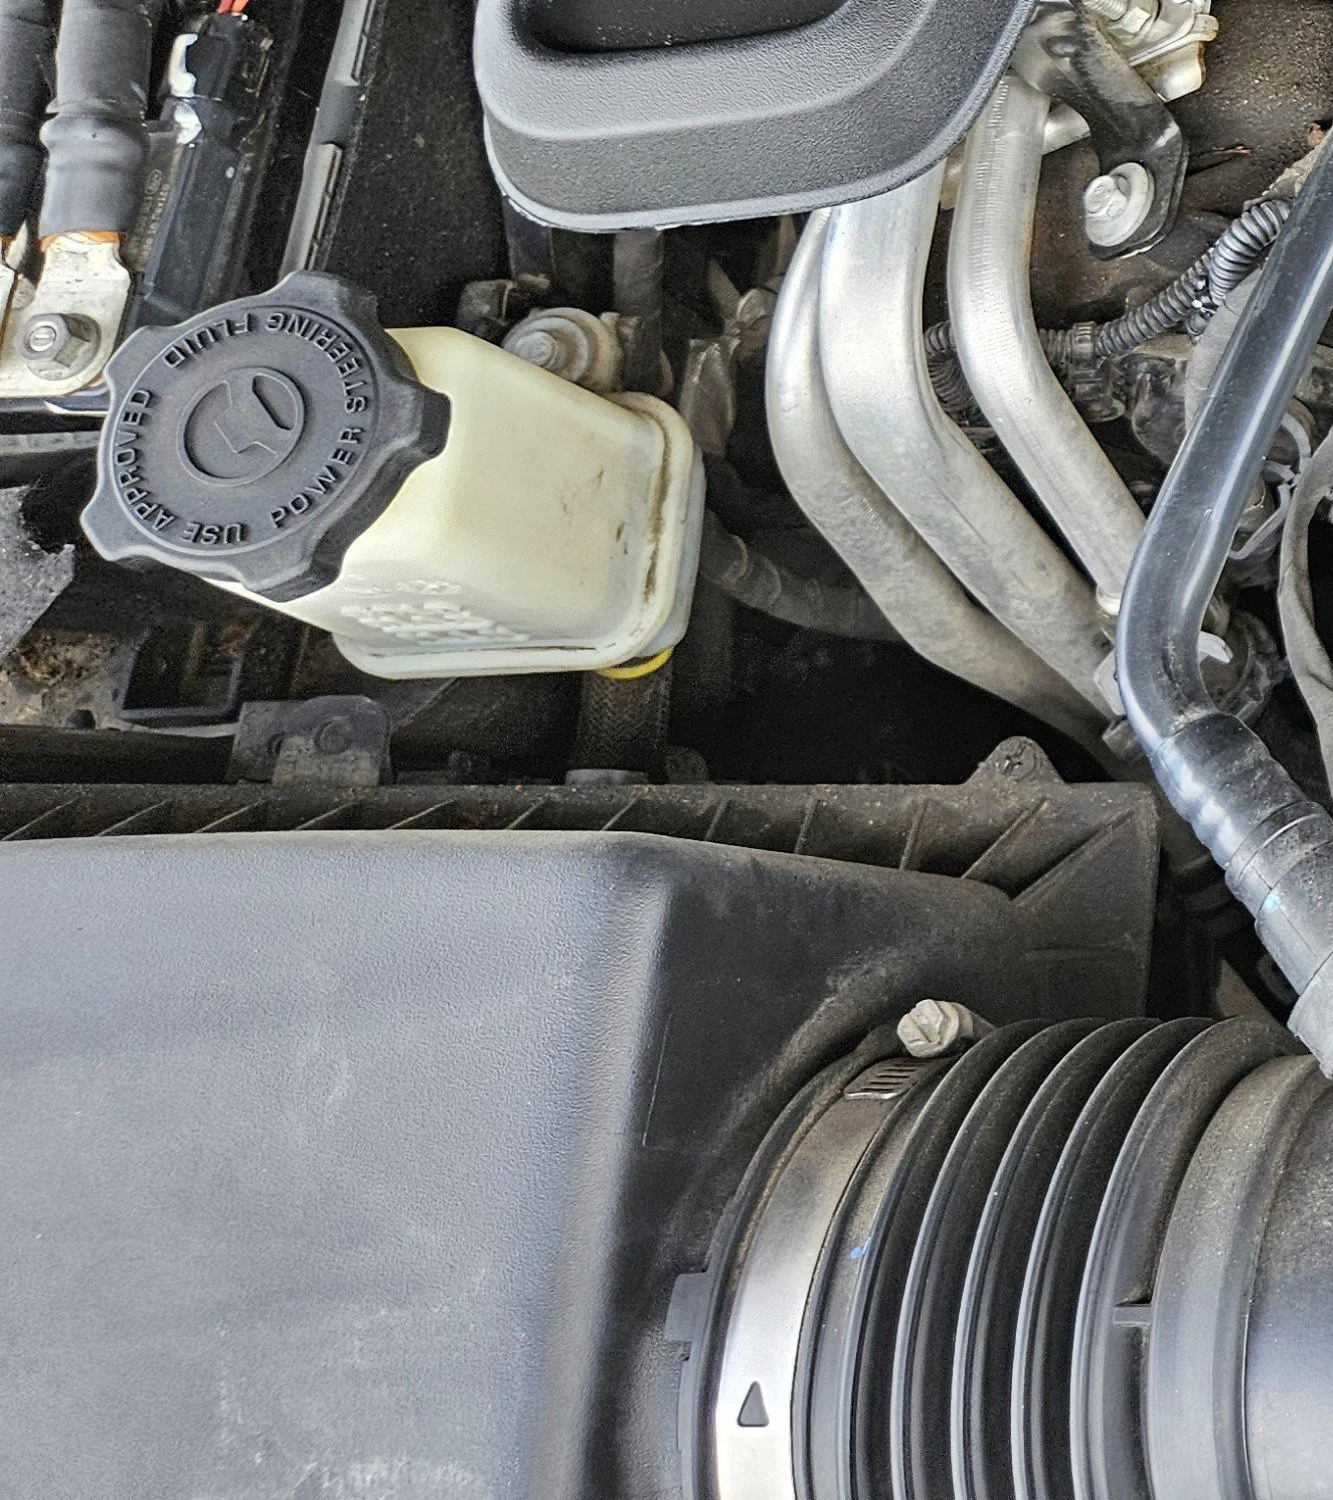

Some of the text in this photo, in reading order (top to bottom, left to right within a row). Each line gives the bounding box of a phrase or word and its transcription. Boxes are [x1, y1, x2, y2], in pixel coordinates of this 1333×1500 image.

[117, 311, 368, 545] USE APPROVED POWER STEERING FLUID
